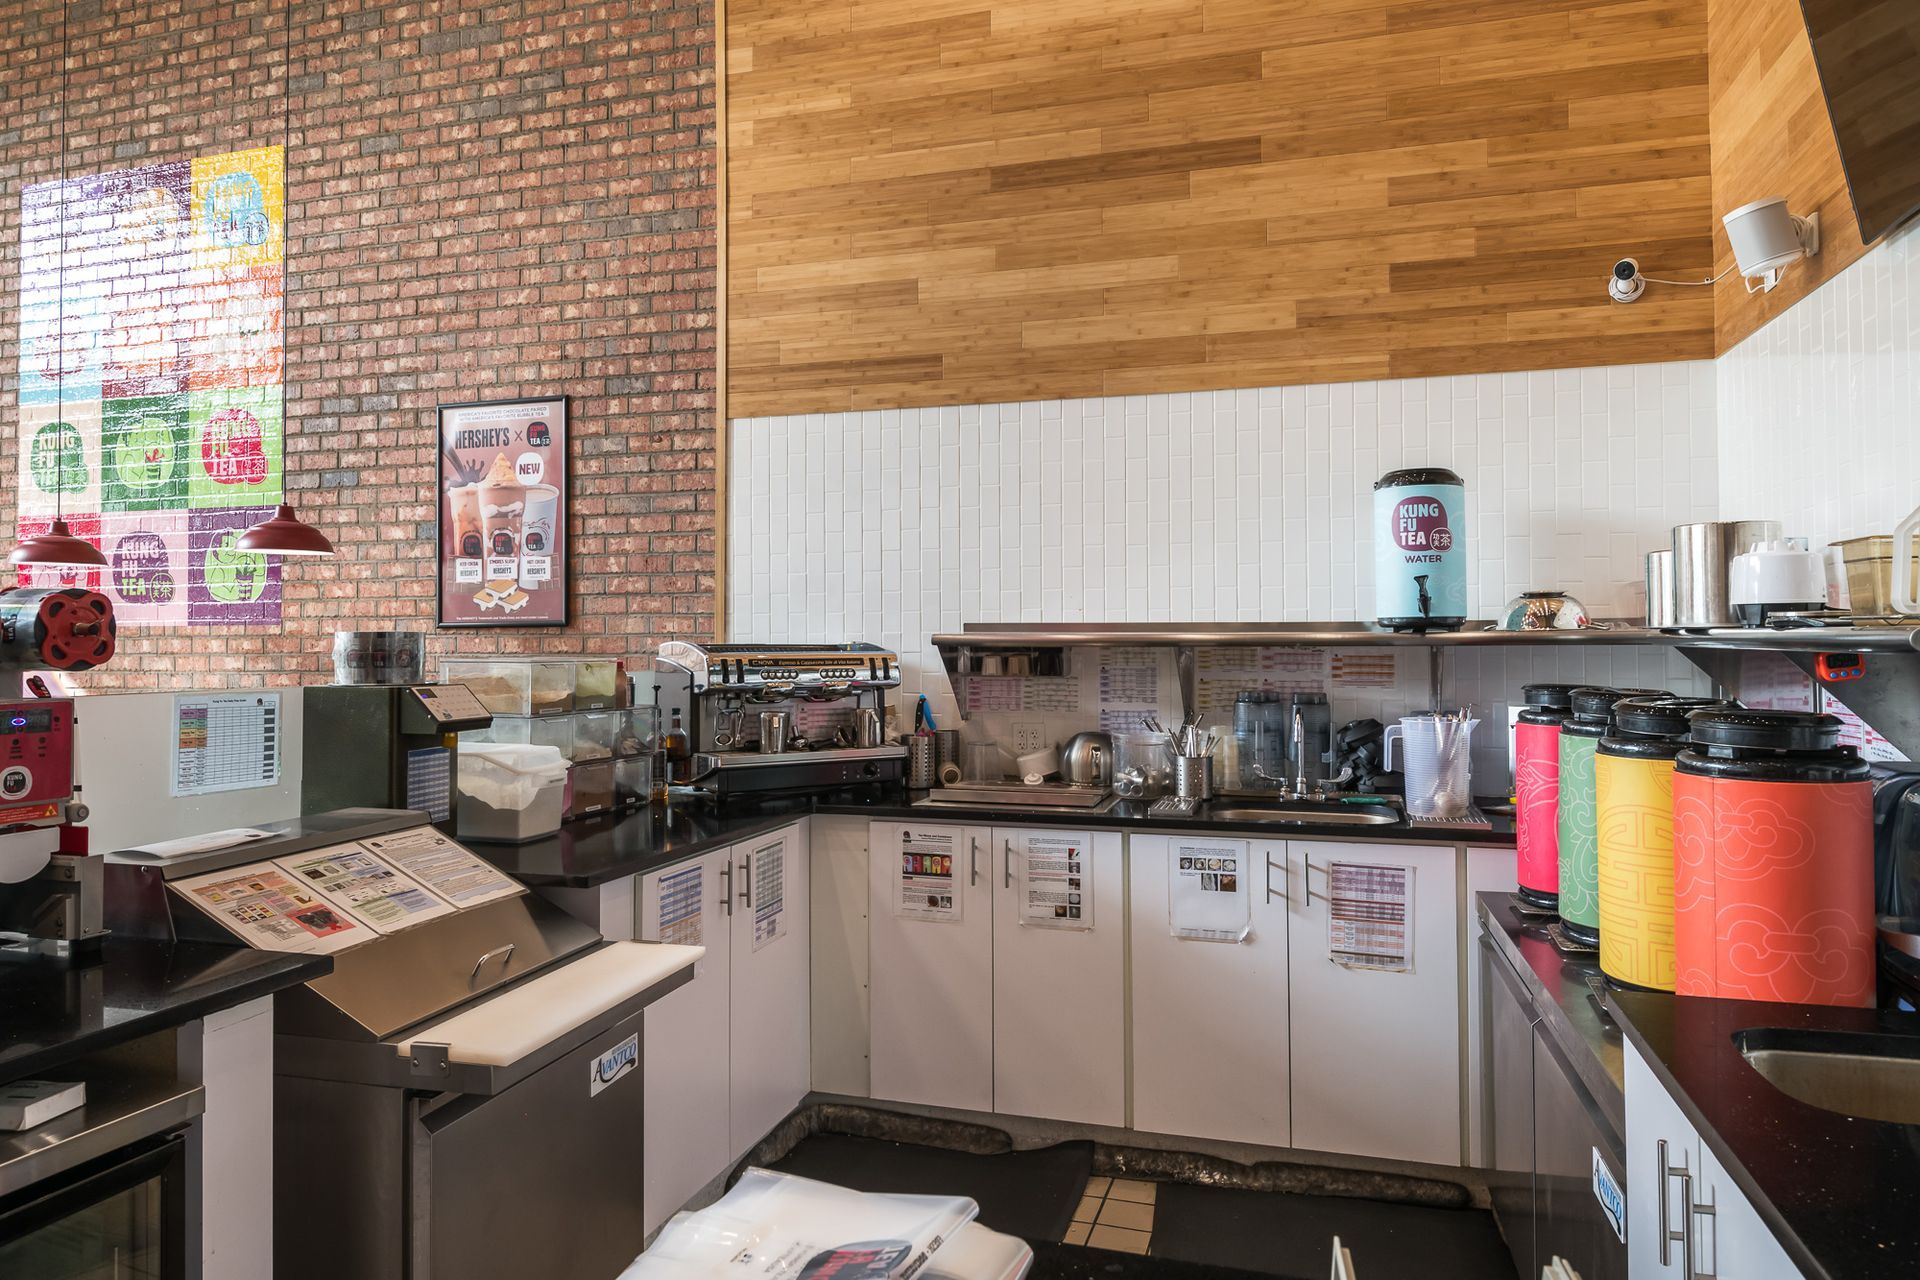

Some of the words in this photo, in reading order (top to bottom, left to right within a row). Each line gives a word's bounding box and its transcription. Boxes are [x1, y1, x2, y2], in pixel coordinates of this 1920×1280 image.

[455, 427, 510, 449] HERSHEY'S
[212, 459, 238, 475] TEA
[519, 463, 540, 475] NEW
[1400, 504, 1439, 518] KUNG
[1400, 519, 1416, 532] FU
[1400, 532, 1426, 546] TEA
[122, 540, 159, 559] KUNG
[1405, 555, 1442, 564] WATER
[122, 560, 138, 577] FU
[122, 578, 146, 596] TEA
[592, 1042, 637, 1083] AVANTCO
